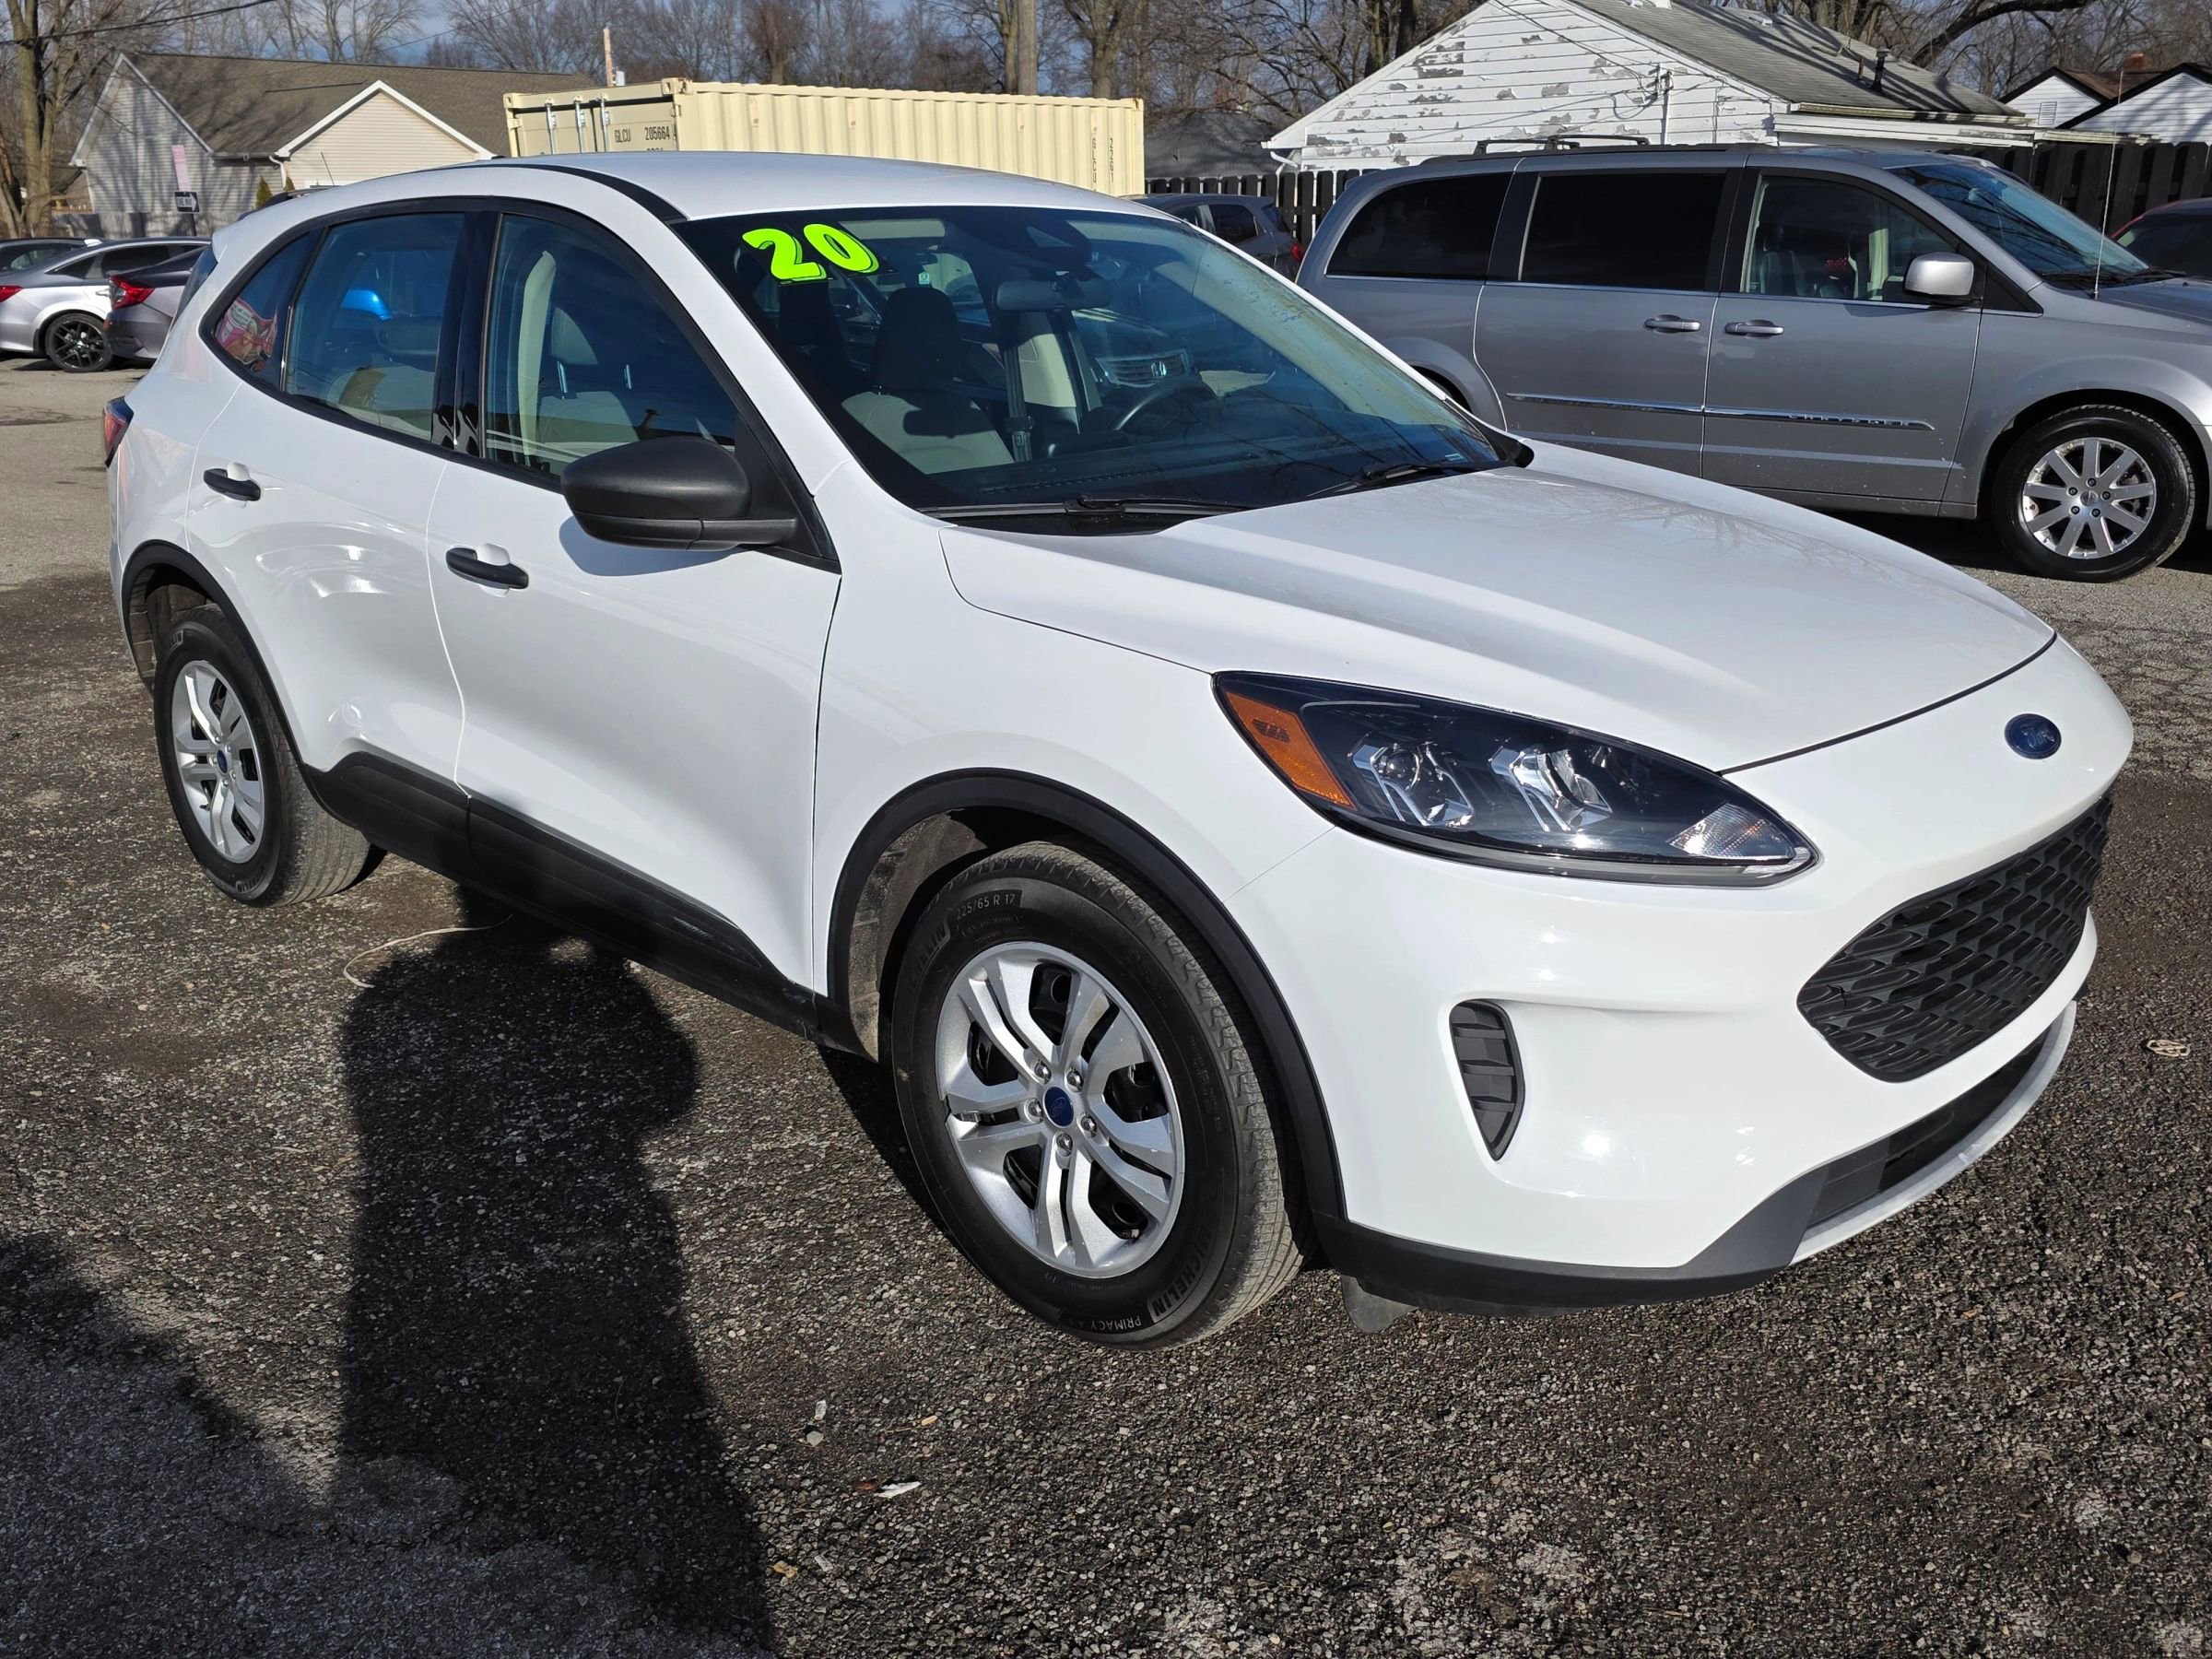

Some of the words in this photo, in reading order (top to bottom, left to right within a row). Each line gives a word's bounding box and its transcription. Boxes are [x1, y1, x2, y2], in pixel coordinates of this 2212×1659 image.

[615, 128, 630, 143] GLCU
[644, 126, 670, 140] 205664
[742, 224, 879, 281] 20
[956, 896, 990, 920] 225/65
[993, 894, 1001, 907] R
[1005, 893, 1016, 905] 17
[1151, 1227, 1212, 1317] MICHELIN
[1090, 1314, 1143, 1331] PRIMACY
